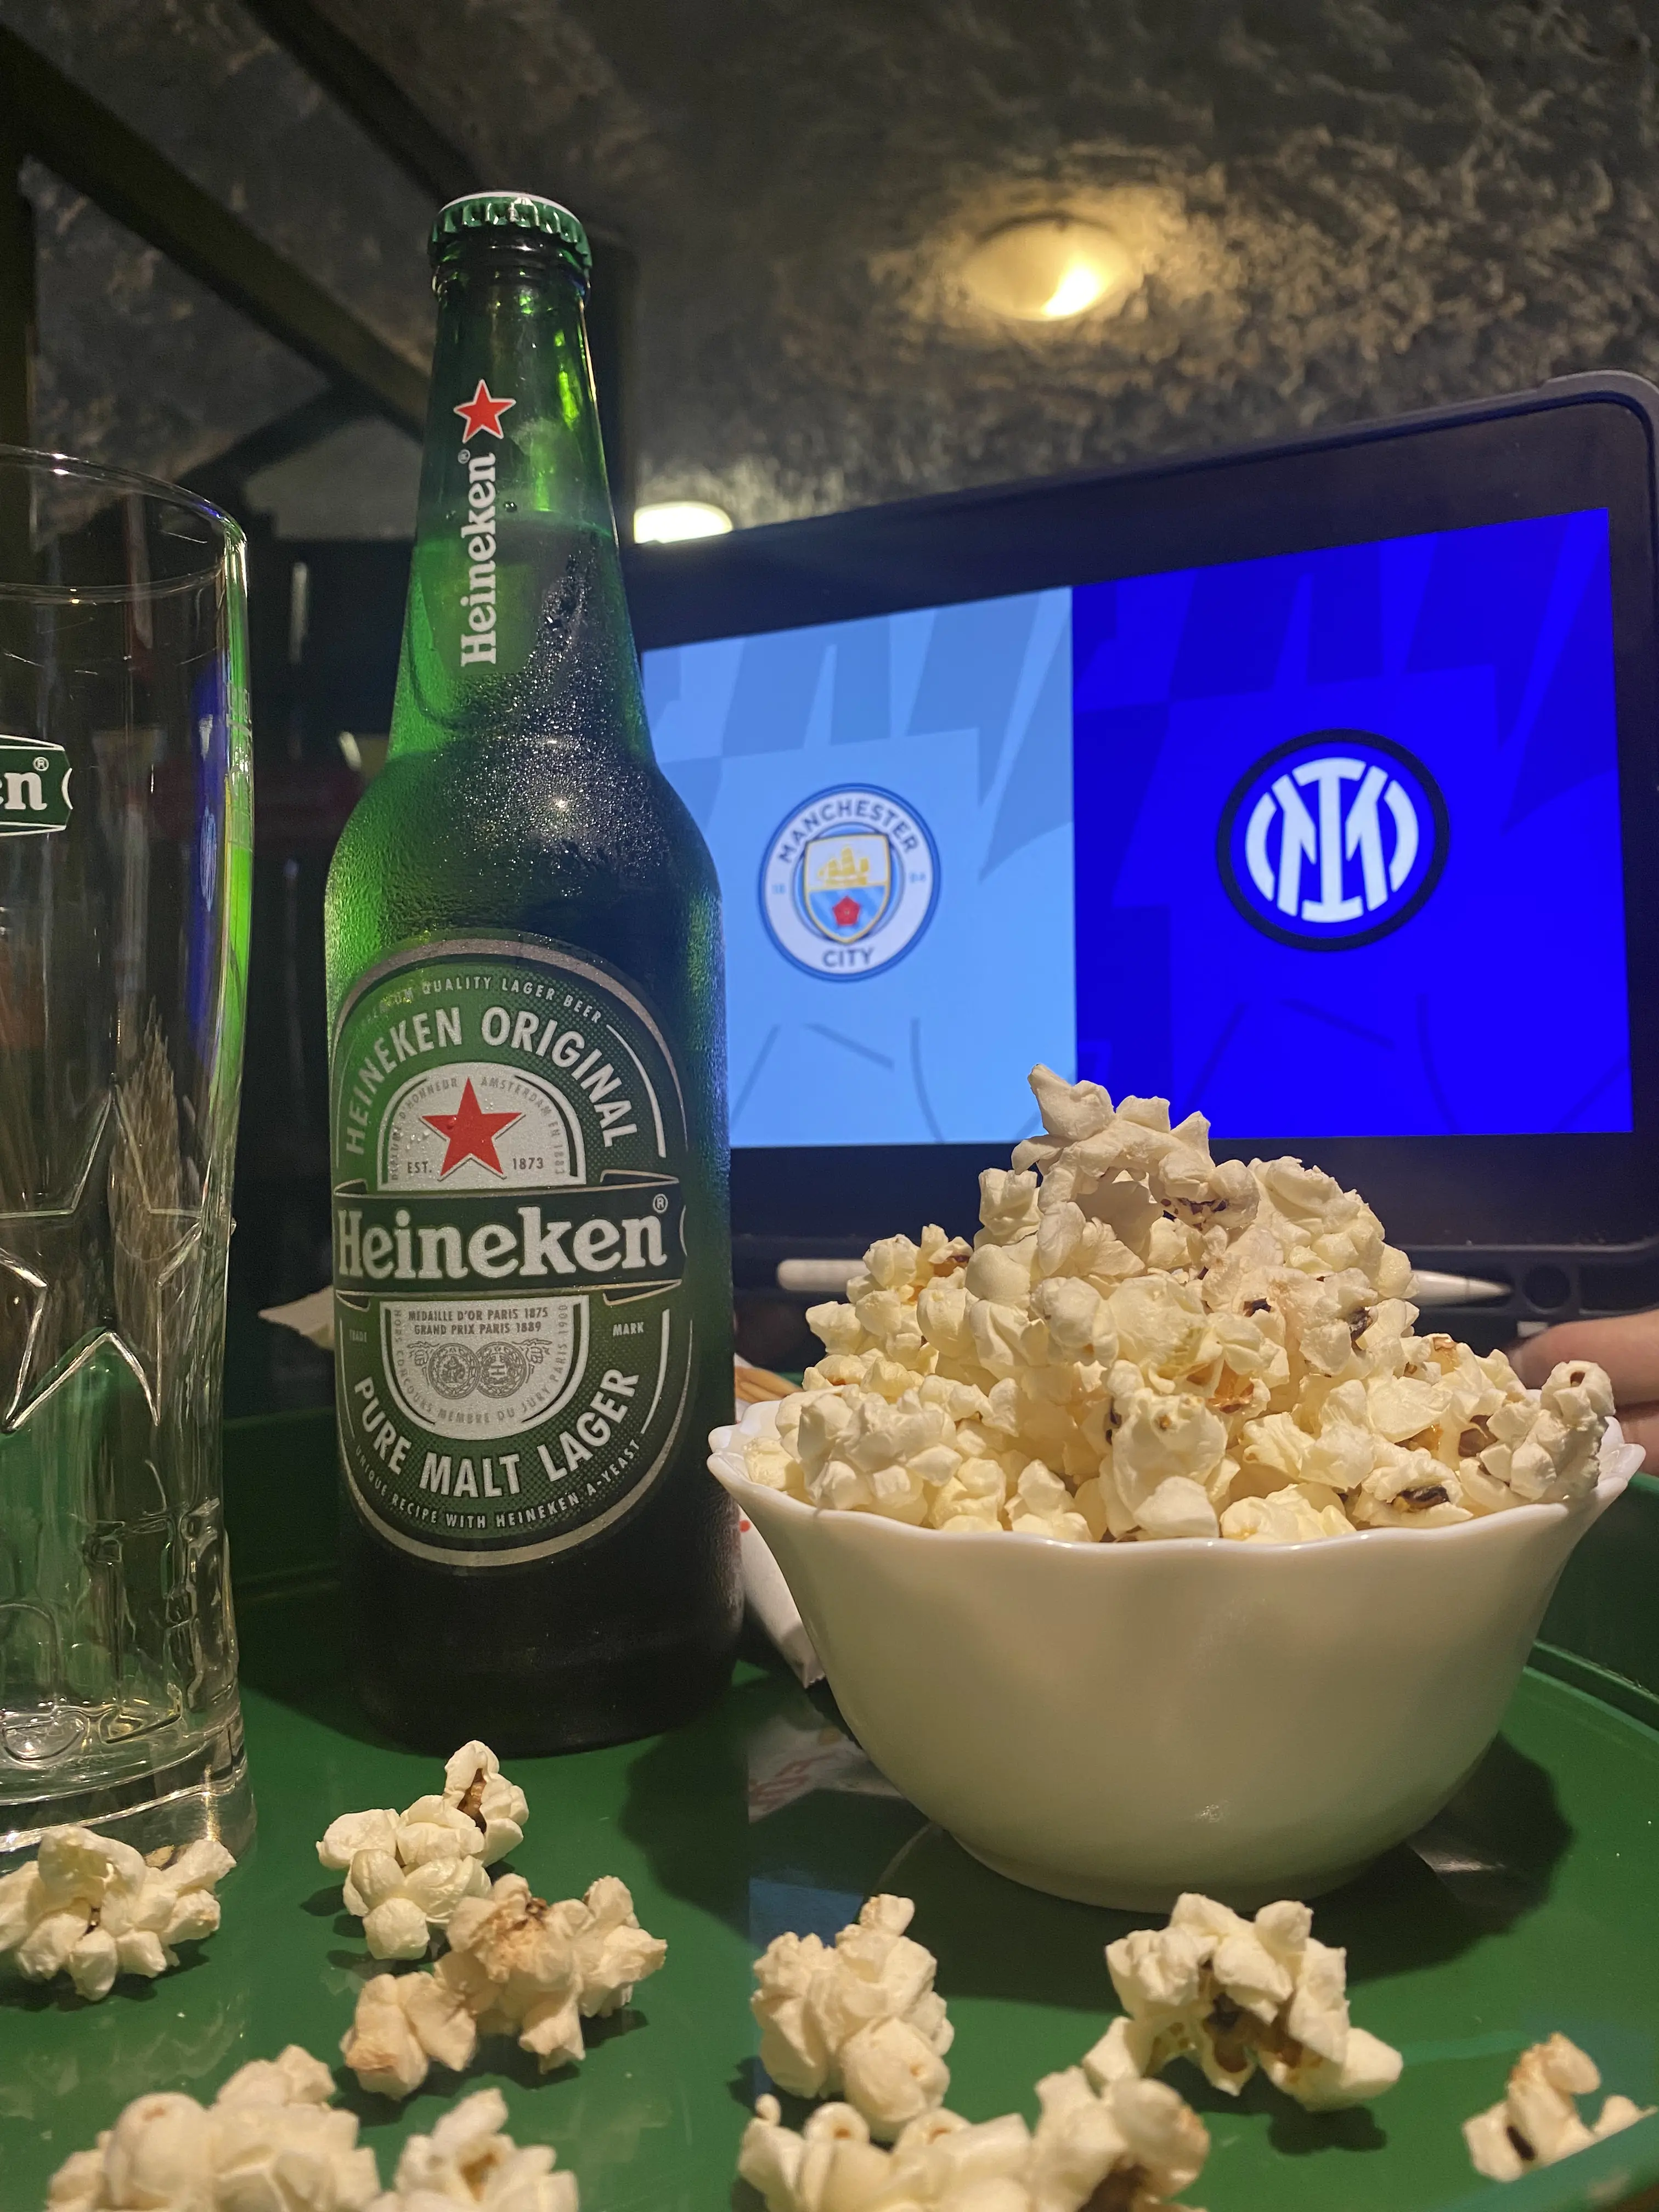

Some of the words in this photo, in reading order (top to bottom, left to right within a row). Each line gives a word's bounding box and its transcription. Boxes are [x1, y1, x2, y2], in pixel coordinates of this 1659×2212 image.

[778, 799, 920, 863] MANCHESTER
[823, 947, 874, 967] CITY
[422, 977, 492, 995] QUALITY
[502, 978, 555, 1001] LAGER
[563, 994, 601, 1023] BEER
[346, 1007, 462, 1155] HEINEKEN
[481, 1006, 637, 1148] ORIGINAL
[481, 1076, 551, 1117] AMSTERDAM
[407, 1161, 432, 1174] EST.
[512, 1157, 544, 1170] 1873
[408, 1310, 453, 1322] MEDAILLE
[457, 1310, 483, 1321] D'OR
[487, 1308, 518, 1321] PARIS
[524, 1307, 549, 1318] 1875
[414, 1324, 447, 1335] GRAND
[451, 1324, 475, 1335] PRIX
[479, 1323, 510, 1334] PARIS
[516, 1321, 541, 1333] 1889
[558, 1304, 568, 1335] 1900
[612, 1322, 645, 1336] MARK
[549, 1343, 568, 1382] PARIS
[521, 1384, 551, 1412] JURY
[498, 1407, 515, 1421] DU
[354, 1376, 411, 1475] PURE
[419, 1452, 520, 1498] MALT
[537, 1368, 640, 1482] LAGER
[356, 1444, 388, 1497] UNIQUE
[392, 1493, 438, 1523] RECIPE
[446, 1513, 486, 1528] WITH
[496, 1492, 579, 1528] HEINEKEN
[586, 1438, 641, 1496] A-YEAST
